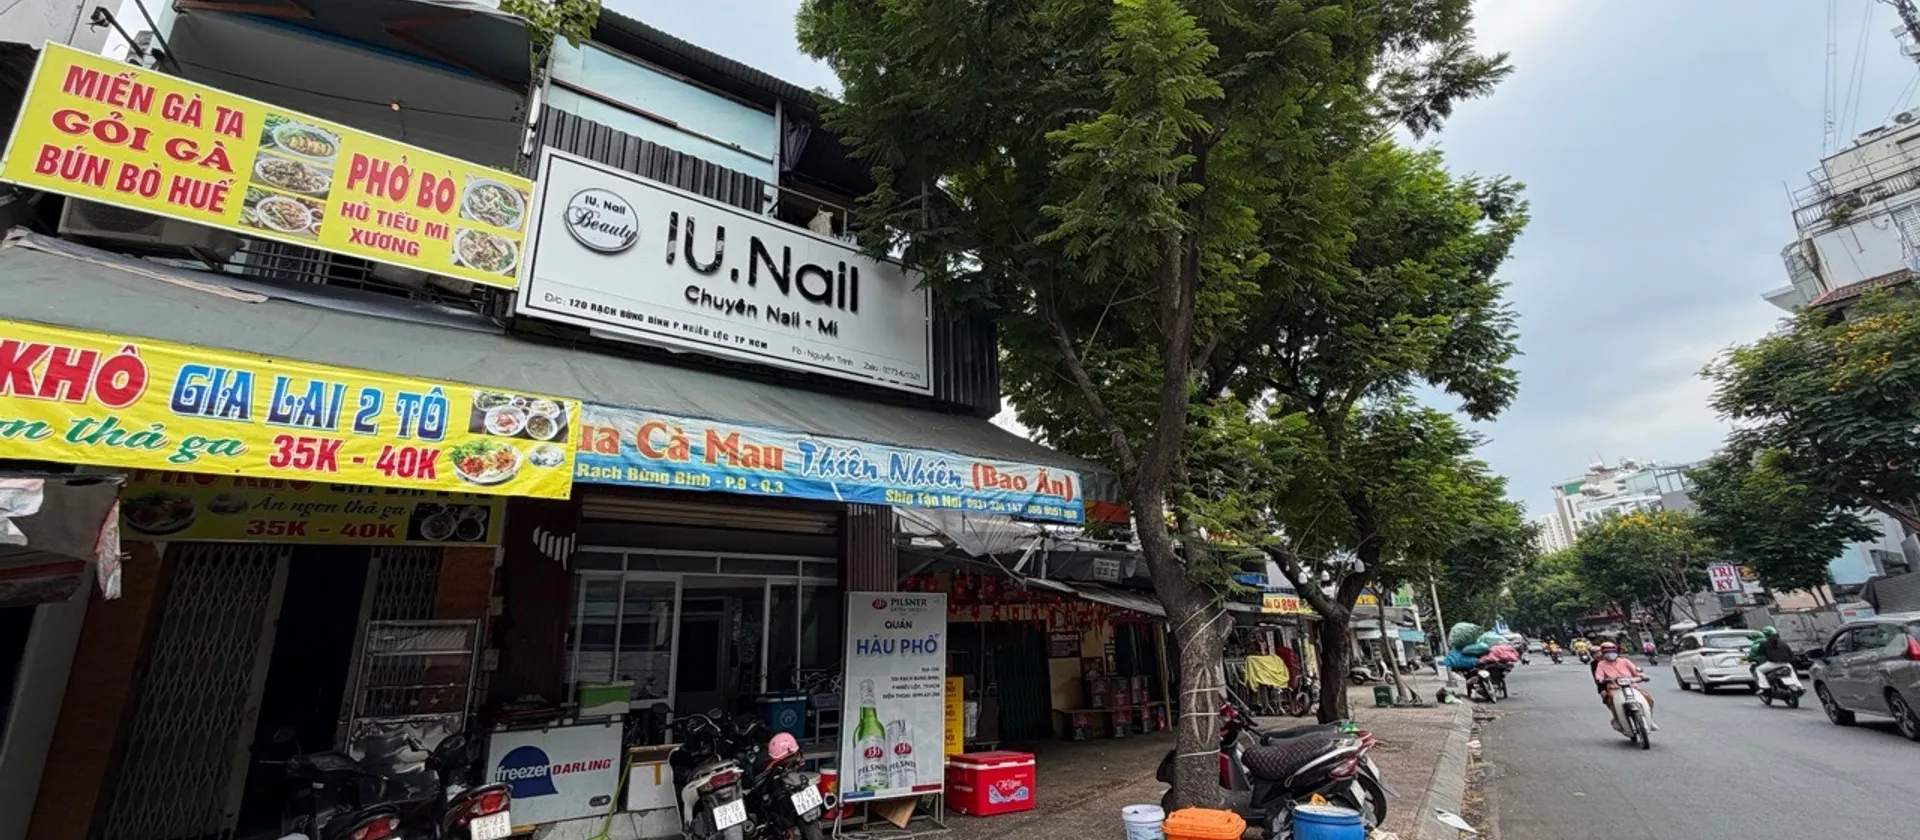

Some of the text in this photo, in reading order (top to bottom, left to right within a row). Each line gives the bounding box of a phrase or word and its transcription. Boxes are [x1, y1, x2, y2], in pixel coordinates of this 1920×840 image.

[62, 65, 245, 138] MIẾN GÀ TA
[52, 109, 235, 174] GỎI GÀ
[35, 143, 238, 214] BÚN BÒ HUẾ
[346, 152, 456, 214] PHỞ BÒ
[603, 200, 626, 215] Nail
[424, 221, 450, 240] MÌ
[570, 206, 638, 246] Beauty
[569, 298, 588, 310] 120
[590, 303, 617, 317] RẠCH
[684, 285, 757, 318] Chuyên
[766, 304, 800, 328] Nail
[0, 340, 450, 443] KHÔ GIA LAI 2 TÔ
[65, 415, 170, 451] thả
[168, 434, 250, 465] ga
[269, 434, 344, 473] 35K
[375, 444, 441, 481] 40K
[635, 420, 691, 463] Cà
[703, 427, 785, 471] Mau
[796, 440, 880, 482] Thiên
[888, 451, 965, 489] Nhiên
[971, 461, 1028, 492] (Bao
[1035, 468, 1074, 502] Ăn)
[576, 463, 622, 482] Rạch
[760, 479, 784, 494] Q.3
[252, 493, 406, 520] Ăn ngon thả ga
[885, 489, 913, 504] Ship
[246, 519, 308, 537] 35K
[340, 522, 398, 538] 40K
[890, 598, 927, 606] PILSNER
[885, 618, 912, 629] QUÁN
[856, 632, 940, 654] HÀU PHỐ
[495, 759, 612, 782] freezer DARLING
